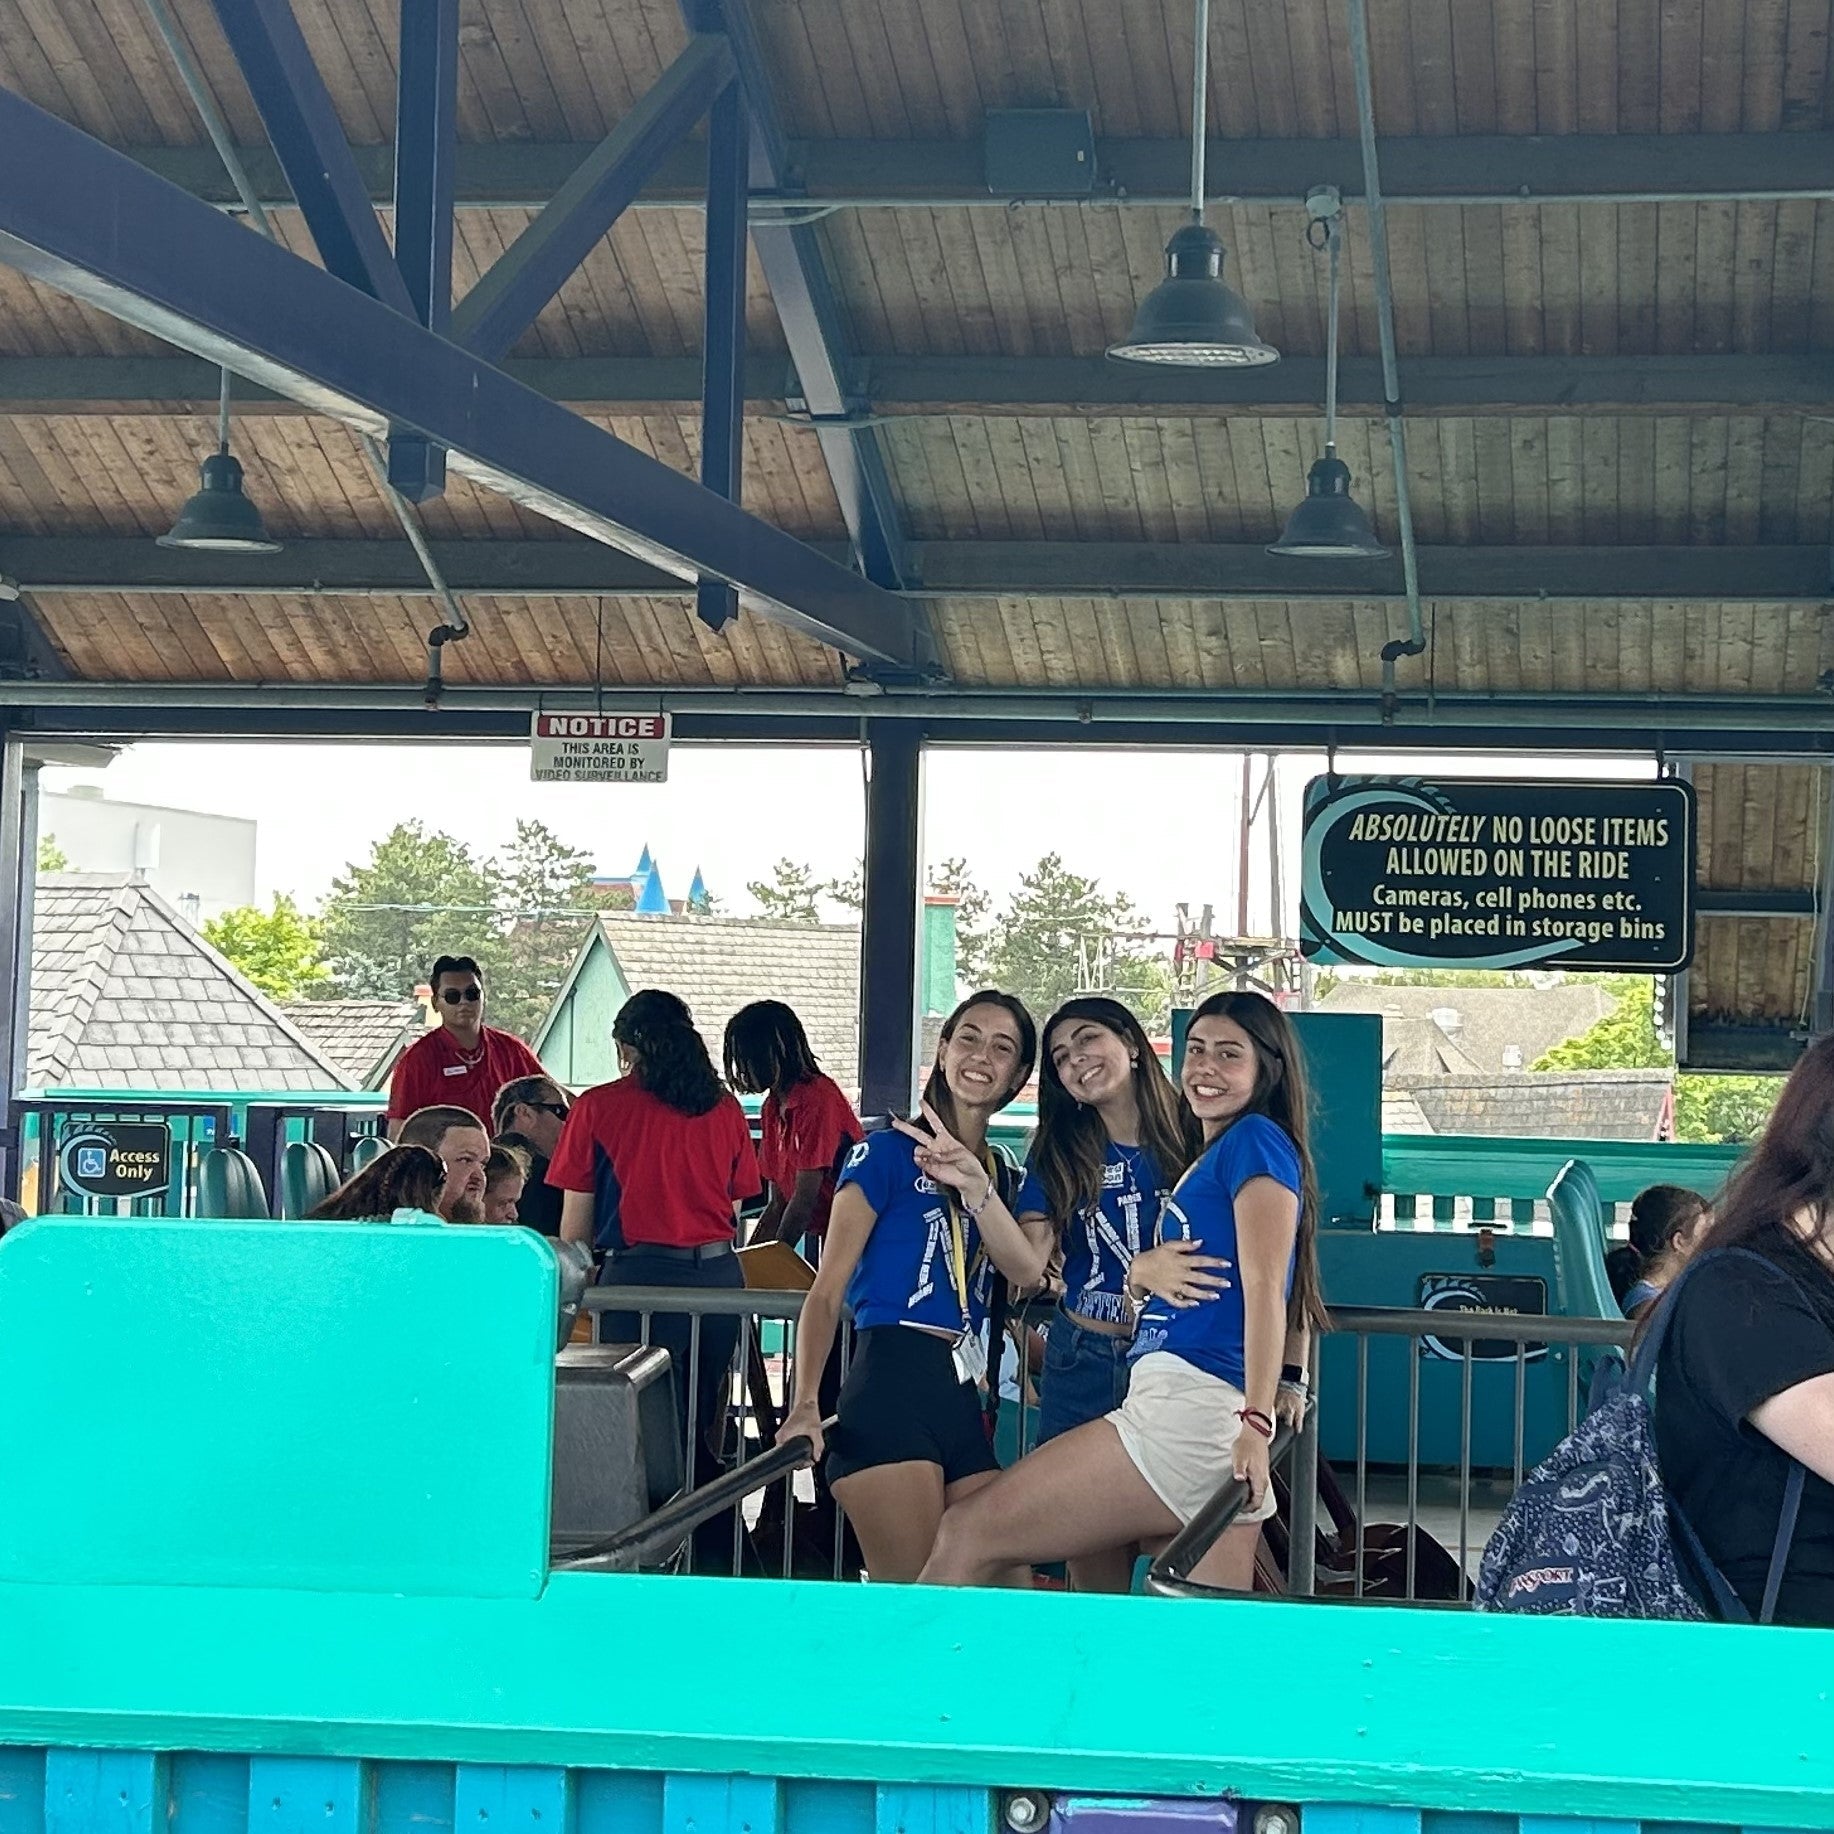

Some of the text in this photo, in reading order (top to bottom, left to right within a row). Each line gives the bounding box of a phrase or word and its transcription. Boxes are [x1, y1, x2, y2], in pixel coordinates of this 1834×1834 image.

[549, 717, 655, 737] NOTICE
[562, 742, 640, 756] THIS AREA IS
[553, 756, 646, 770] MONITORED BY
[535, 769, 664, 782] VIDEO SURVEILLANCE
[1348, 814, 1670, 847] ABSOLUTELY NO LOOSE ITEMS
[1386, 847, 1630, 880] ALLOWED ON THE RIDE
[1373, 884, 1642, 913] Cameras, cell phones etc.
[1336, 911, 1666, 943] MUST be placed in storage bins
[109, 1148, 160, 1164] Access
[115, 1165, 154, 1182] Only
